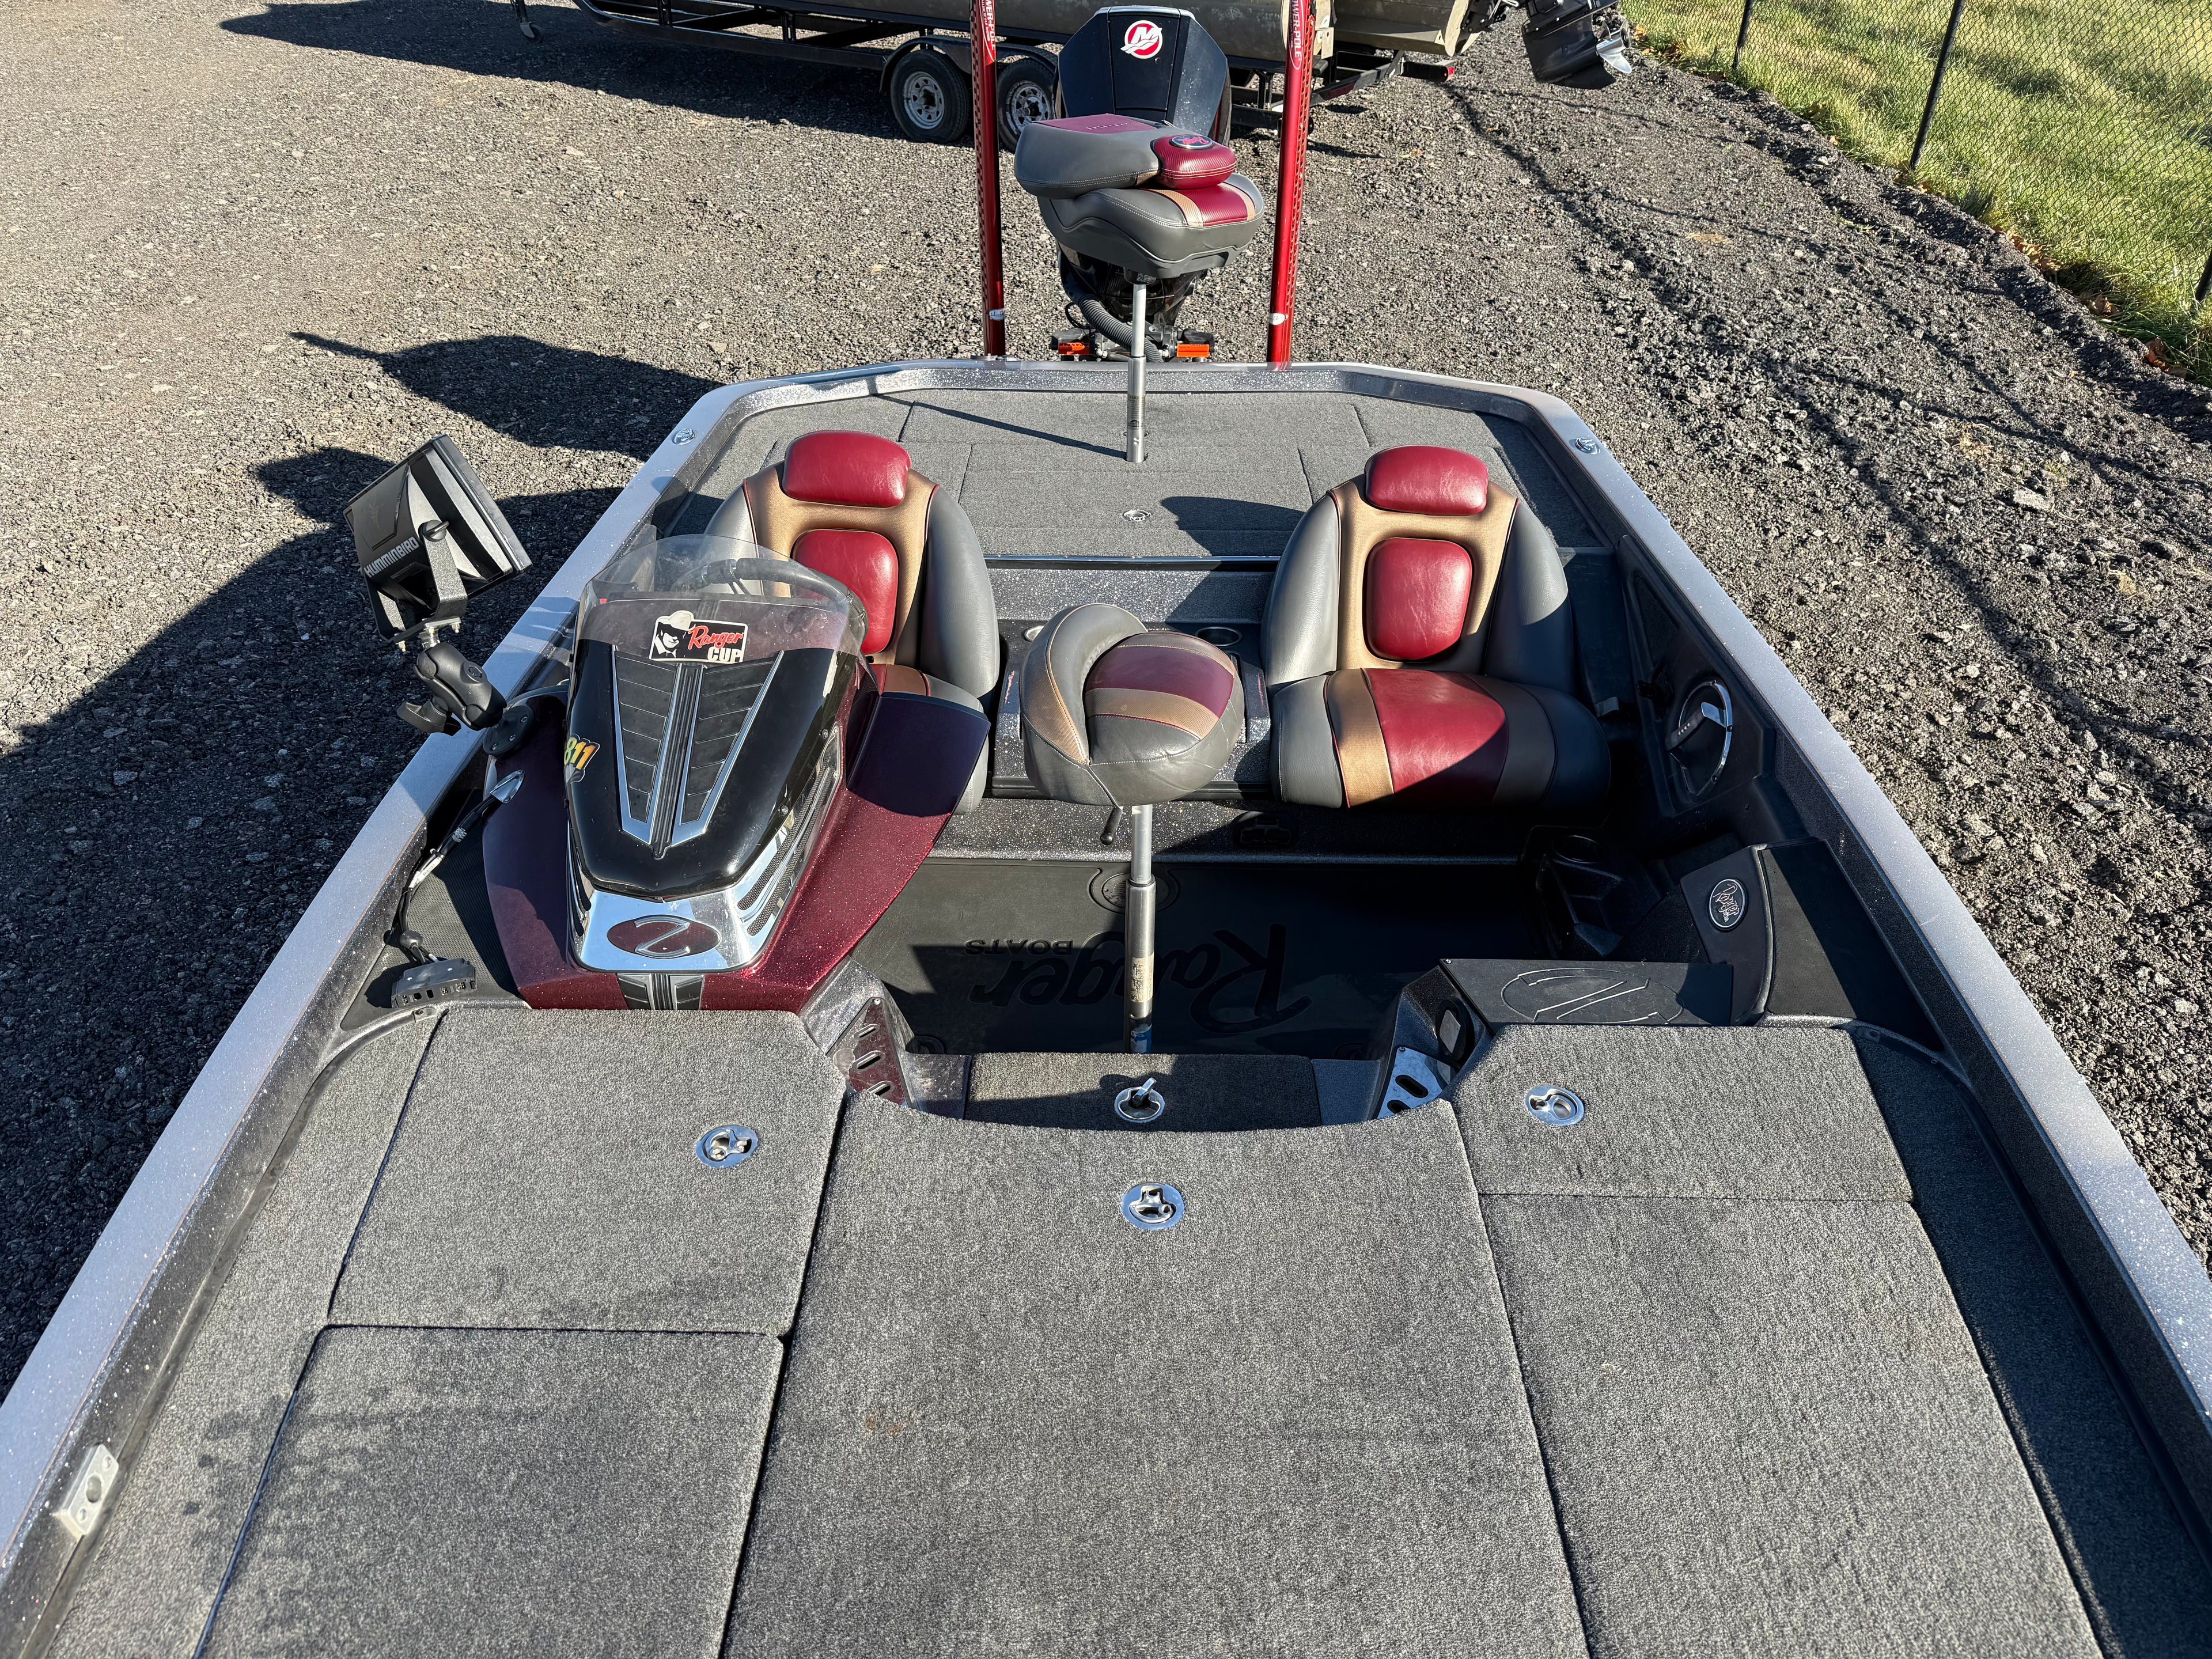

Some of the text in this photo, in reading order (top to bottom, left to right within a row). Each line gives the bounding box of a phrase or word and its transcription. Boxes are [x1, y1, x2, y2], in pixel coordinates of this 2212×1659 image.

[363, 536, 419, 578] HUMMINBIRD
[688, 626, 744, 650] Ranger
[707, 646, 742, 662] CUP
[564, 737, 596, 770] 811
[964, 938, 1073, 956] BOATS
